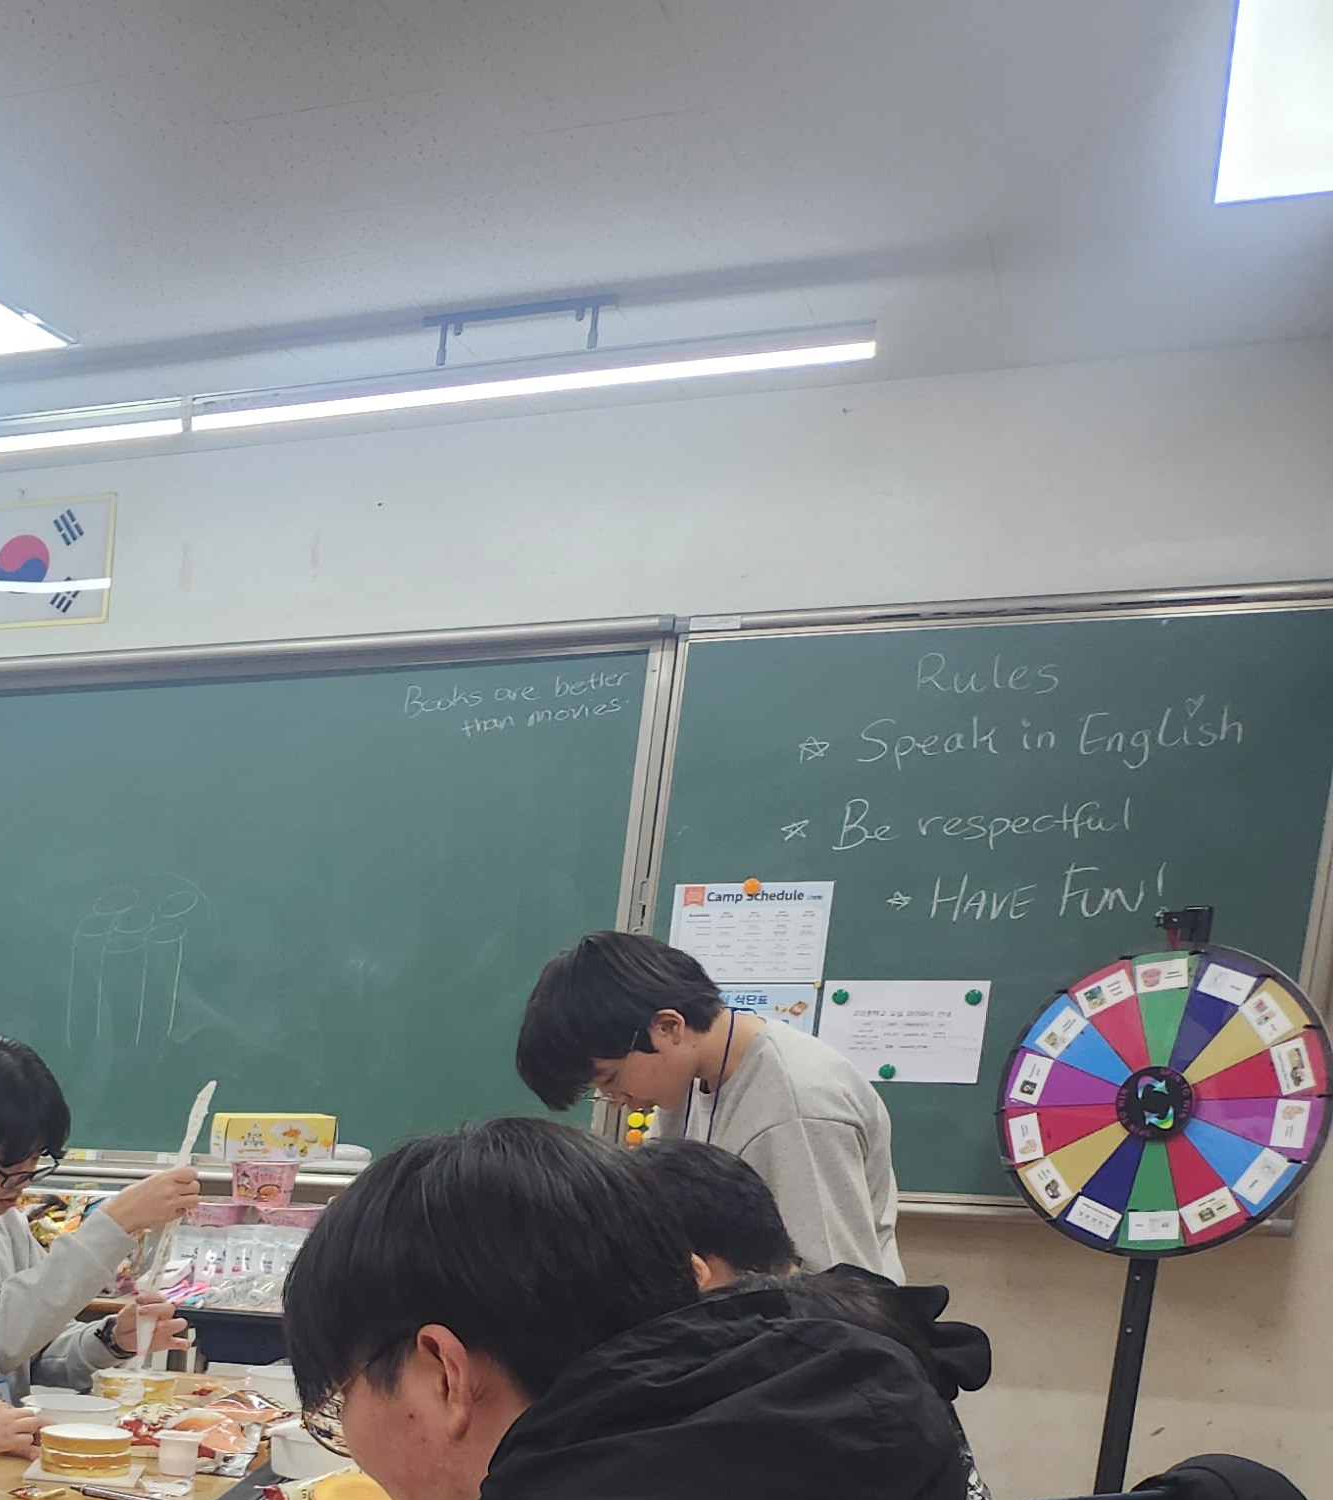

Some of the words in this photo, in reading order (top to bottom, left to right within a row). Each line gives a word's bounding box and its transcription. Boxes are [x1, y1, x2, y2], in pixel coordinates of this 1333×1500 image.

[916, 652, 1060, 694] Rules
[404, 685, 484, 719] Books
[494, 686, 541, 702] are
[554, 672, 632, 699] better
[460, 714, 516, 738] than
[856, 714, 999, 771] Speak
[1020, 718, 1057, 750] in
[1077, 694, 1245, 769] English
[832, 799, 899, 851] Be
[918, 797, 1131, 850] respectful
[706, 891, 743, 904] Camp
[745, 889, 805, 901] Schedule
[929, 874, 1037, 922] HAVE
[1058, 862, 1168, 917] FUN!
[733, 994, 768, 1006] 식단표
